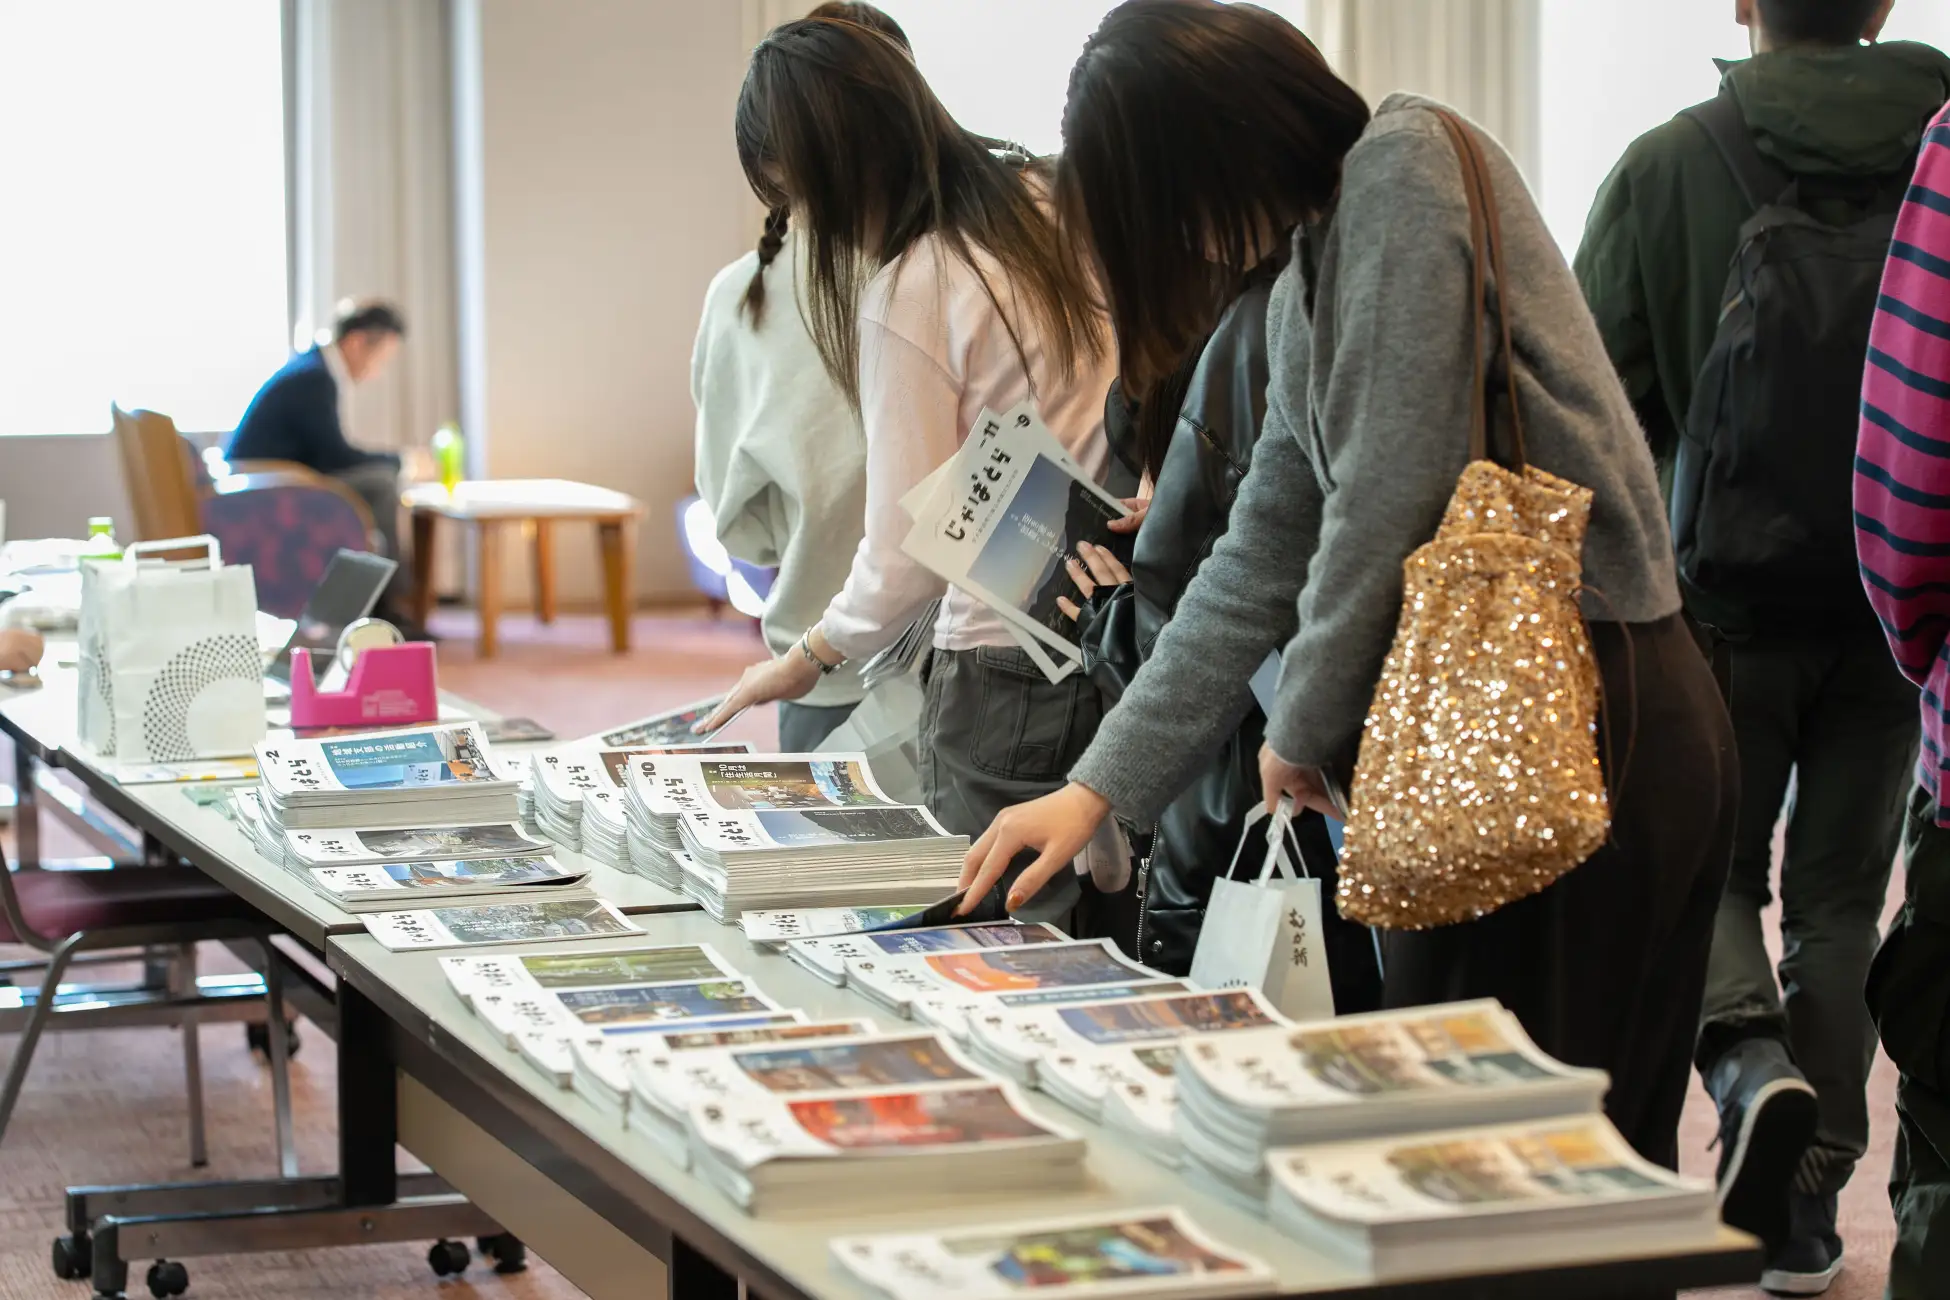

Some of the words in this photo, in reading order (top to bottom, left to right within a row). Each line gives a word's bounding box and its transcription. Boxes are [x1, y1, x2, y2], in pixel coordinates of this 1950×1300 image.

[944, 446, 1013, 542] じゃぱとら
